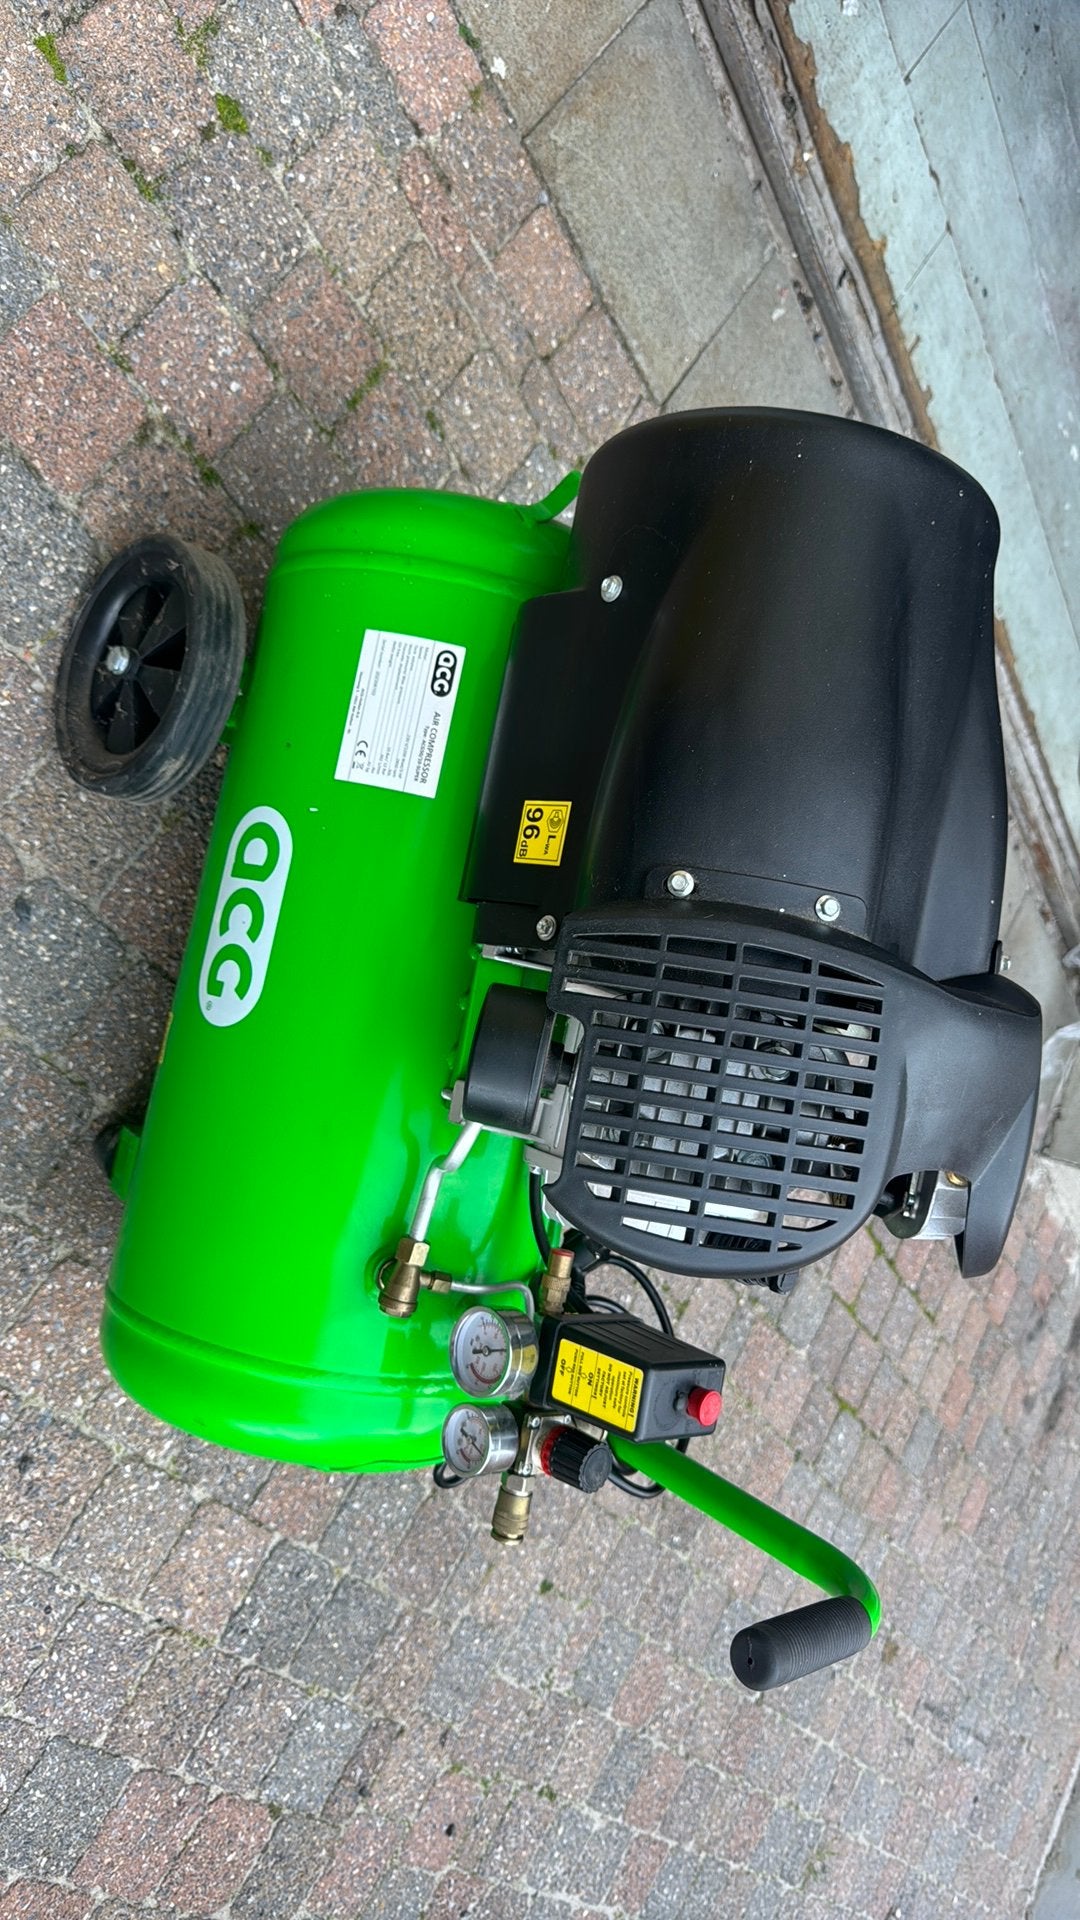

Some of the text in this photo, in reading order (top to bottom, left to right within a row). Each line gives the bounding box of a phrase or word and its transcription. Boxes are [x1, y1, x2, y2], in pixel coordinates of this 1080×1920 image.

[419, 711, 442, 785] AIR COMPRESSOR
[558, 1358, 567, 1377] OFF
[586, 1371, 594, 1387] ON
